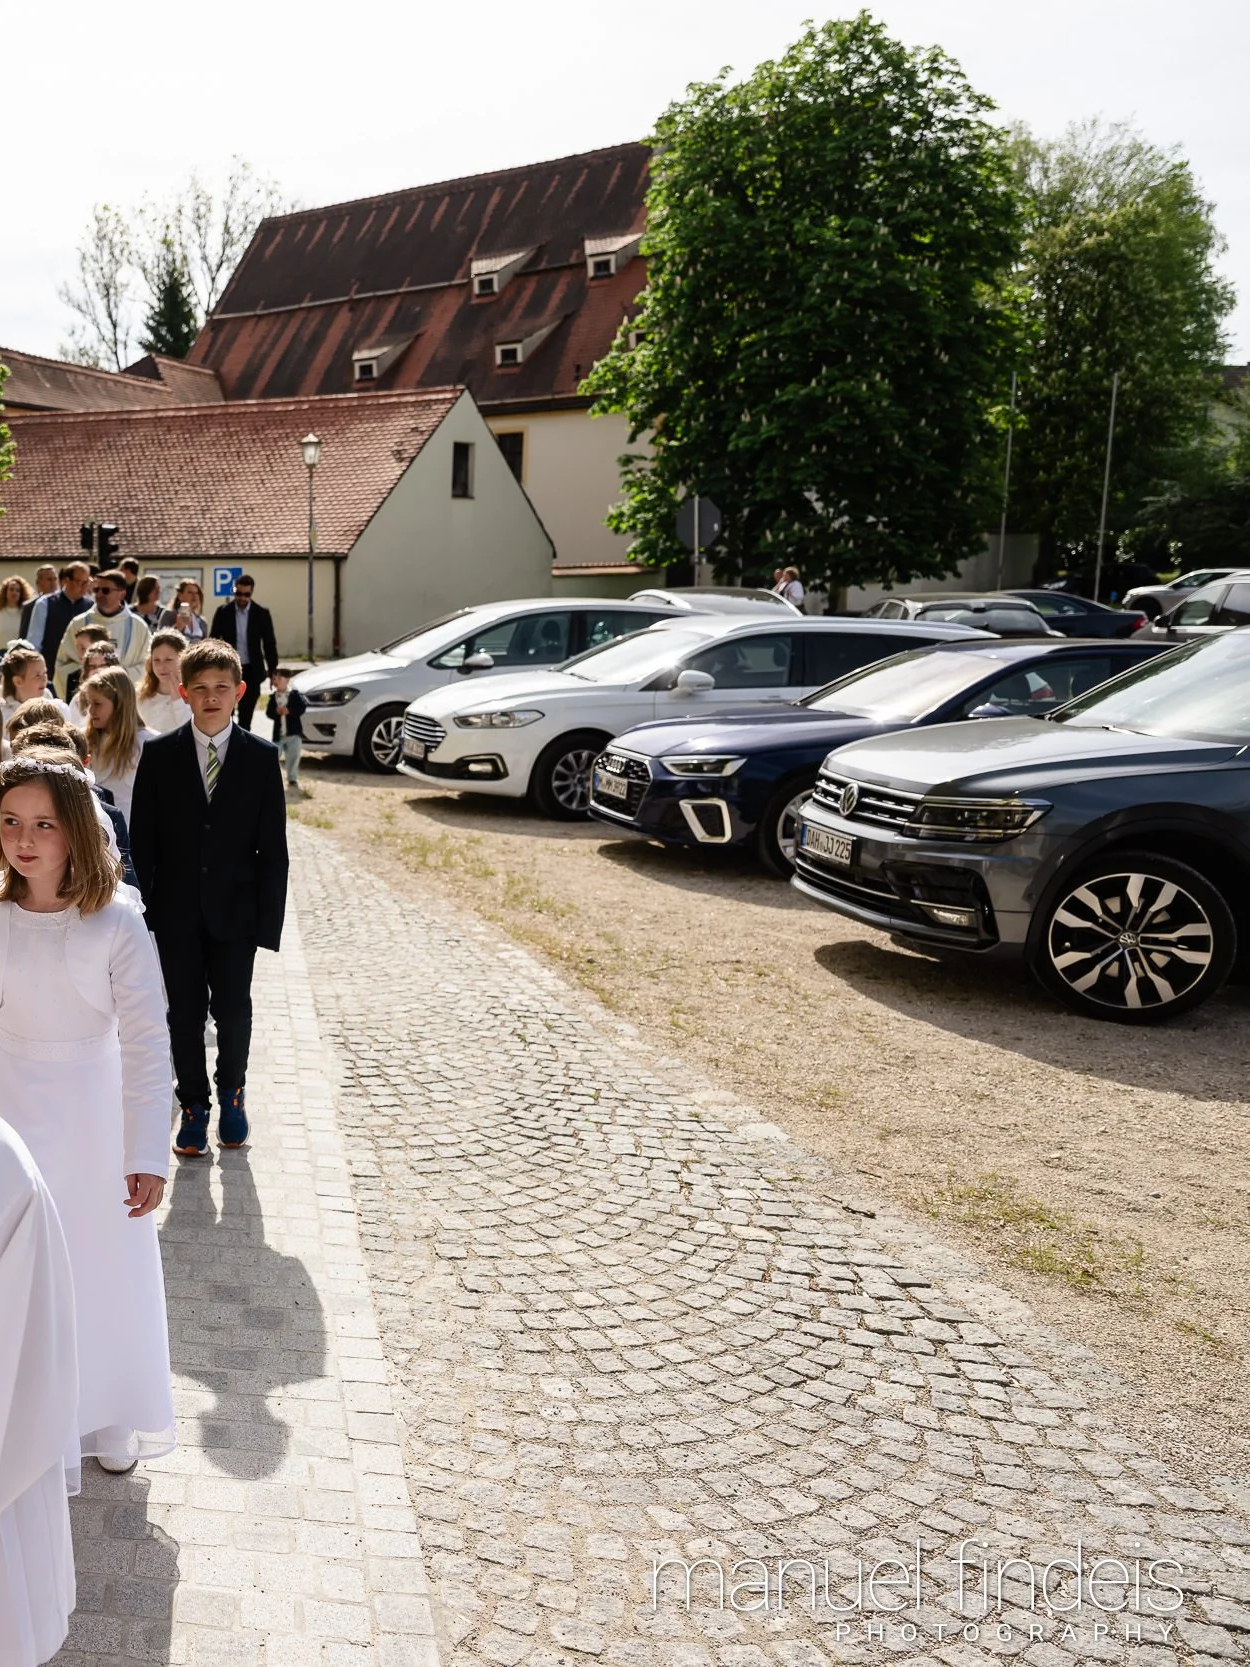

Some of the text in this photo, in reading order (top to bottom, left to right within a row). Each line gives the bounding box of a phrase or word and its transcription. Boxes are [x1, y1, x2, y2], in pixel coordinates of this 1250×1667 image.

[215, 569, 232, 593] P
[823, 835, 833, 854] JJ
[835, 839, 851, 860] 225
